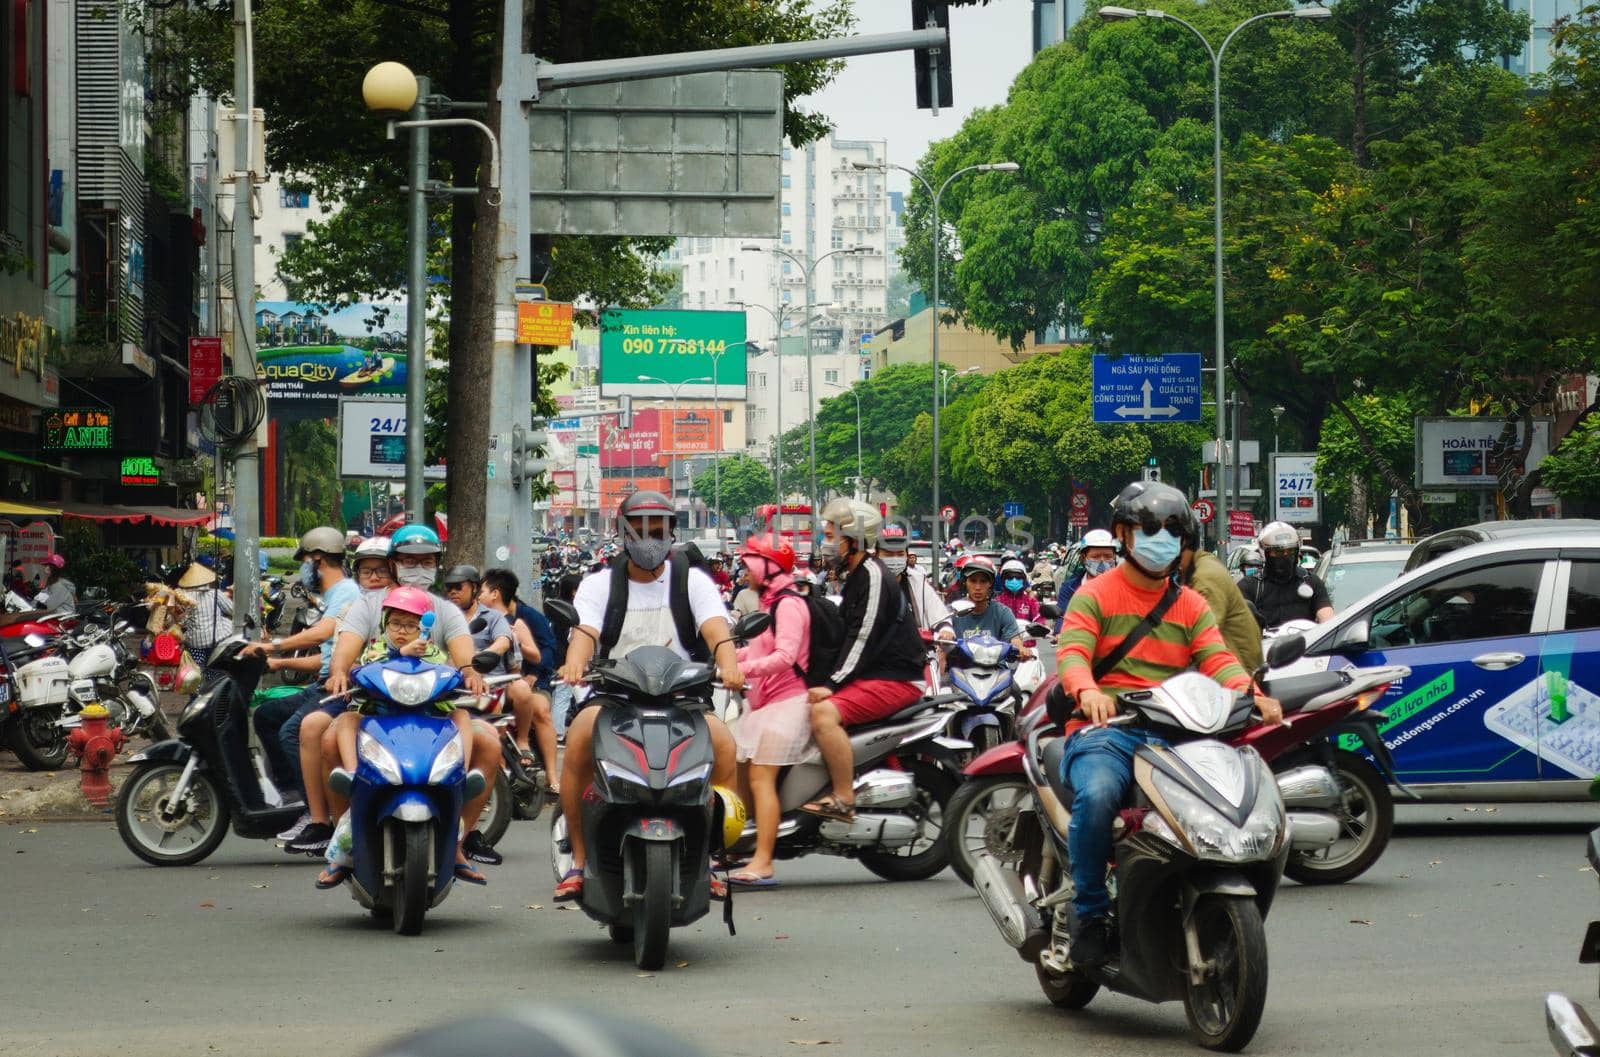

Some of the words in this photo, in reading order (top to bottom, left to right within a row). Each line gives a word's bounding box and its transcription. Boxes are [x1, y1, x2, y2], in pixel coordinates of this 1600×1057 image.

[623, 325, 639, 335] Xin
[642, 325, 659, 335] liên
[662, 325, 677, 337] hệ:
[623, 339, 654, 354] 090
[657, 339, 725, 354] 7788144
[255, 362, 337, 382] AquaCity
[63, 427, 108, 446] ANH
[1442, 436, 1475, 449] HOÀN
[121, 458, 159, 476] HOTEL
[1279, 478, 1313, 491] 24/7
[1404, 696, 1424, 715] lựa
[1425, 680, 1448, 701] nhà
[1384, 688, 1486, 750] Batdongsan.com.vn
